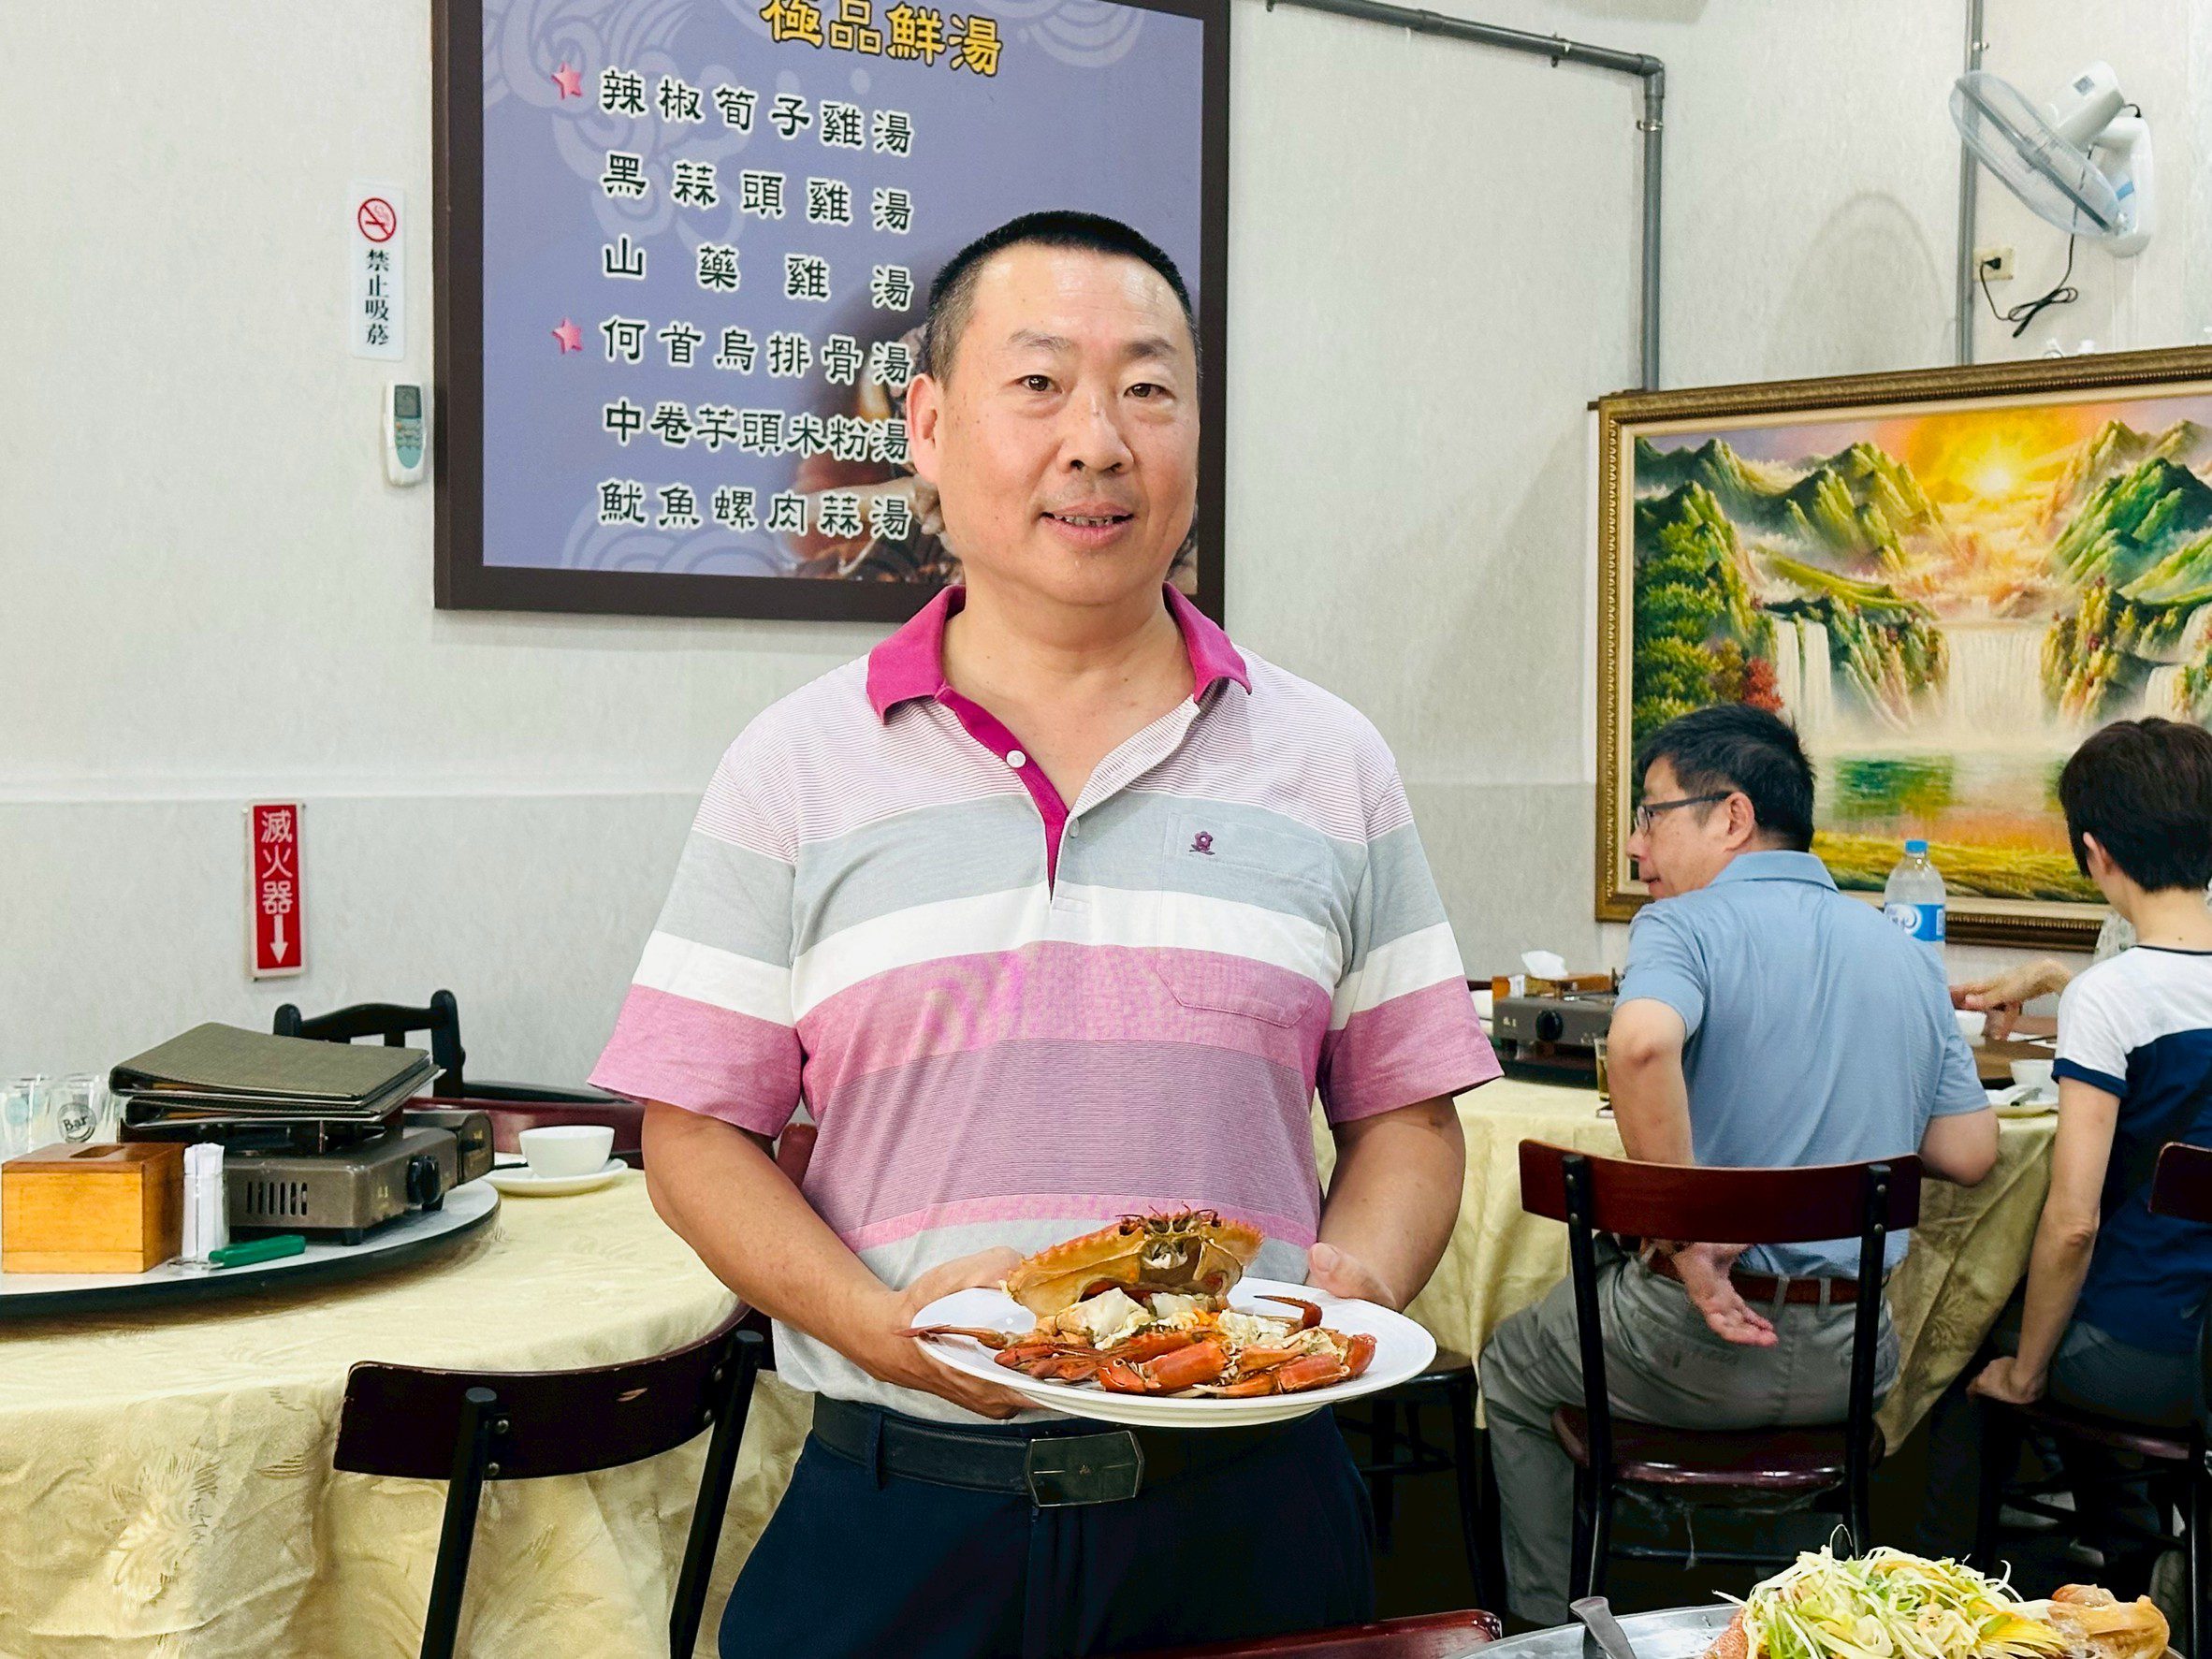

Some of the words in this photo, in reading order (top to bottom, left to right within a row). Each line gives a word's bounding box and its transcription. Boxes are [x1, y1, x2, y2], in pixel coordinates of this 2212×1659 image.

[759, 0, 1003, 77] 極品鮮湯
[602, 69, 912, 154] 辣椒筍子雞湯
[603, 153, 912, 231] 黑蒜頭雞湯
[365, 249, 389, 345] 禁止吸菸
[605, 237, 912, 309] 山藥雞湯
[602, 318, 911, 386] 何首烏排骨湯
[605, 400, 910, 461] 中卷芋頭米粉湯
[601, 482, 910, 536] 魷魚螺肉蒜湯
[261, 809, 293, 916] 滅火器
[63, 1115, 89, 1132] Bar
